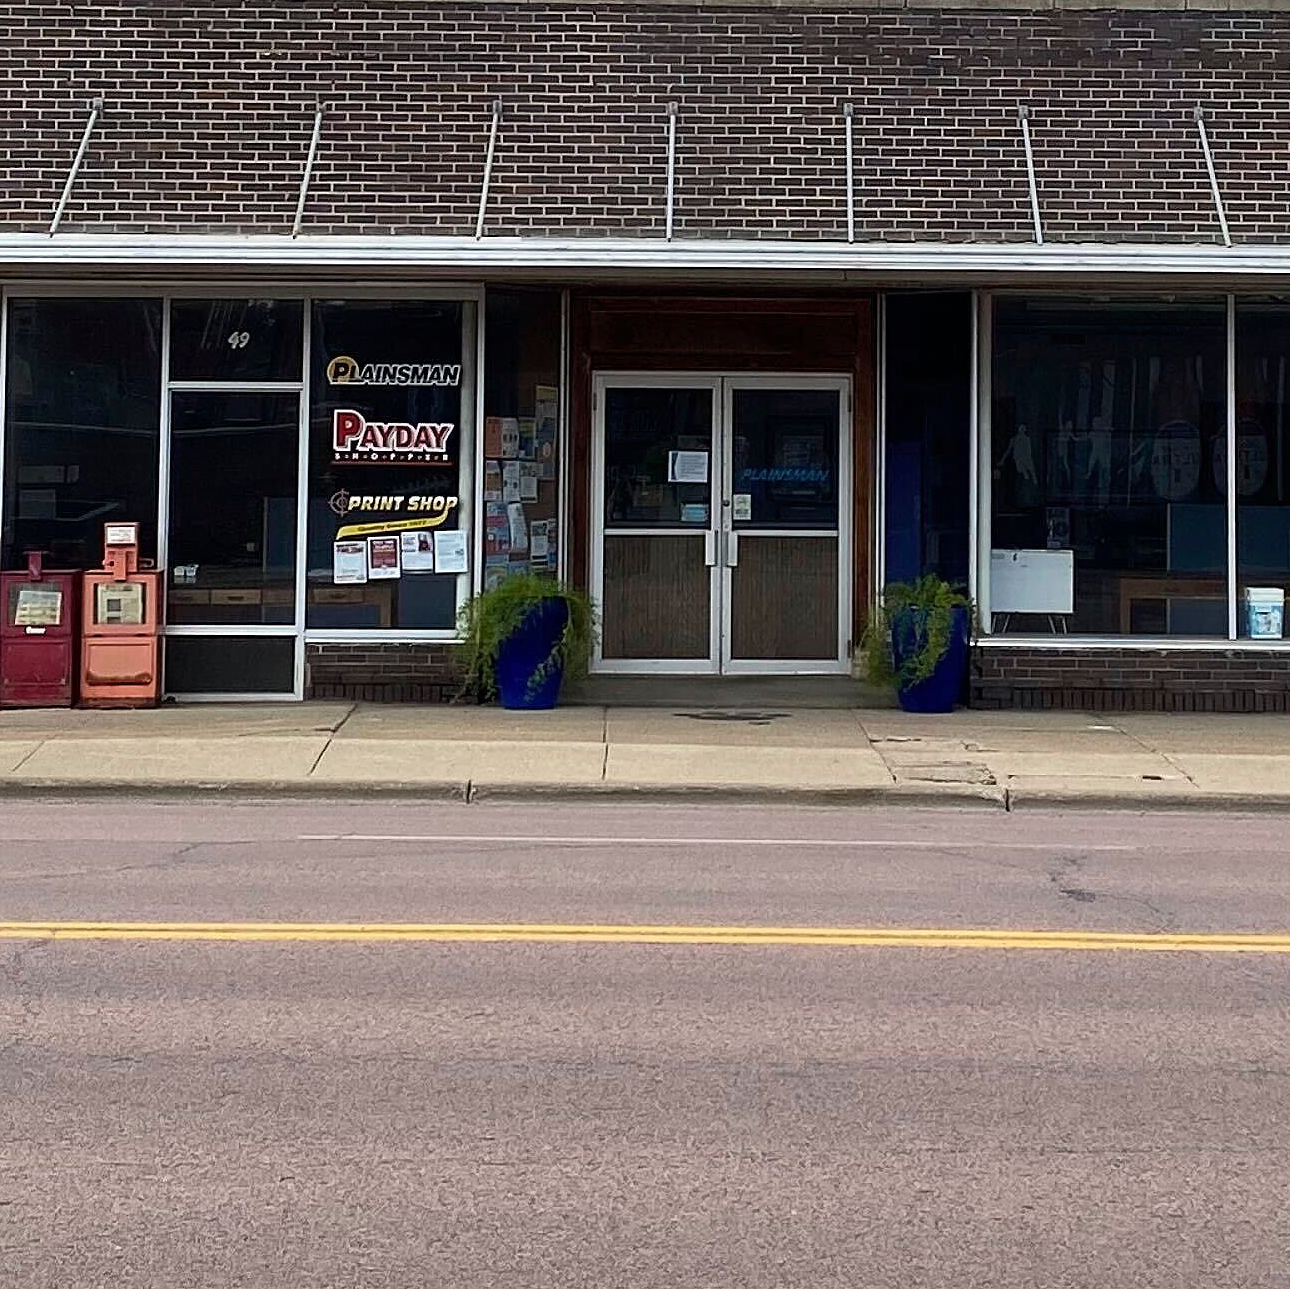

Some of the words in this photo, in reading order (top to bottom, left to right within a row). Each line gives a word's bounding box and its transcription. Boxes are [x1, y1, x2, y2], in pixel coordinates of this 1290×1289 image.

[227, 331, 250, 349] 49
[332, 362, 461, 386] PLAINSMAN
[333, 409, 454, 452] PAYDAY
[347, 496, 405, 511] PRINT
[407, 496, 458, 511] SHOP
